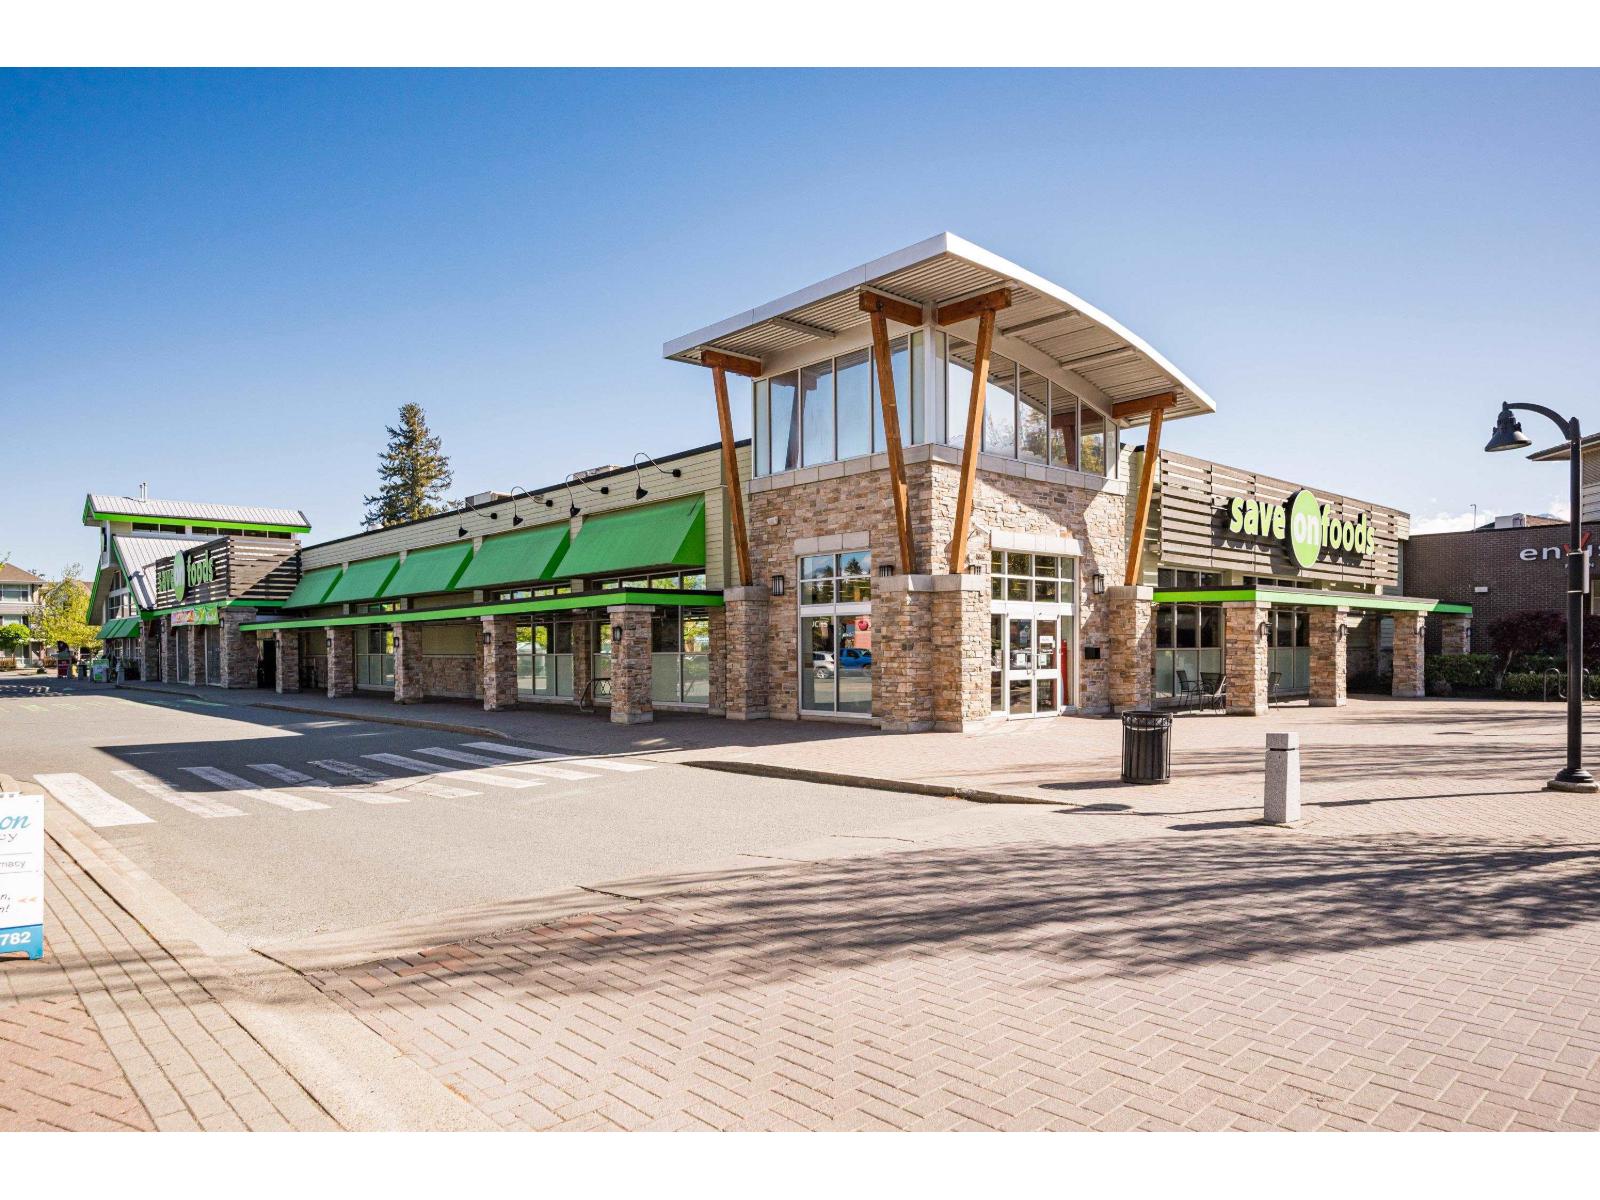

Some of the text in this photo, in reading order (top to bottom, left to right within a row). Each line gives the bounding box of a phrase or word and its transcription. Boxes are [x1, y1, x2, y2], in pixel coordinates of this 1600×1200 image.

[1229, 496, 1376, 556] save on foods
[0, 931, 31, 946] 782
